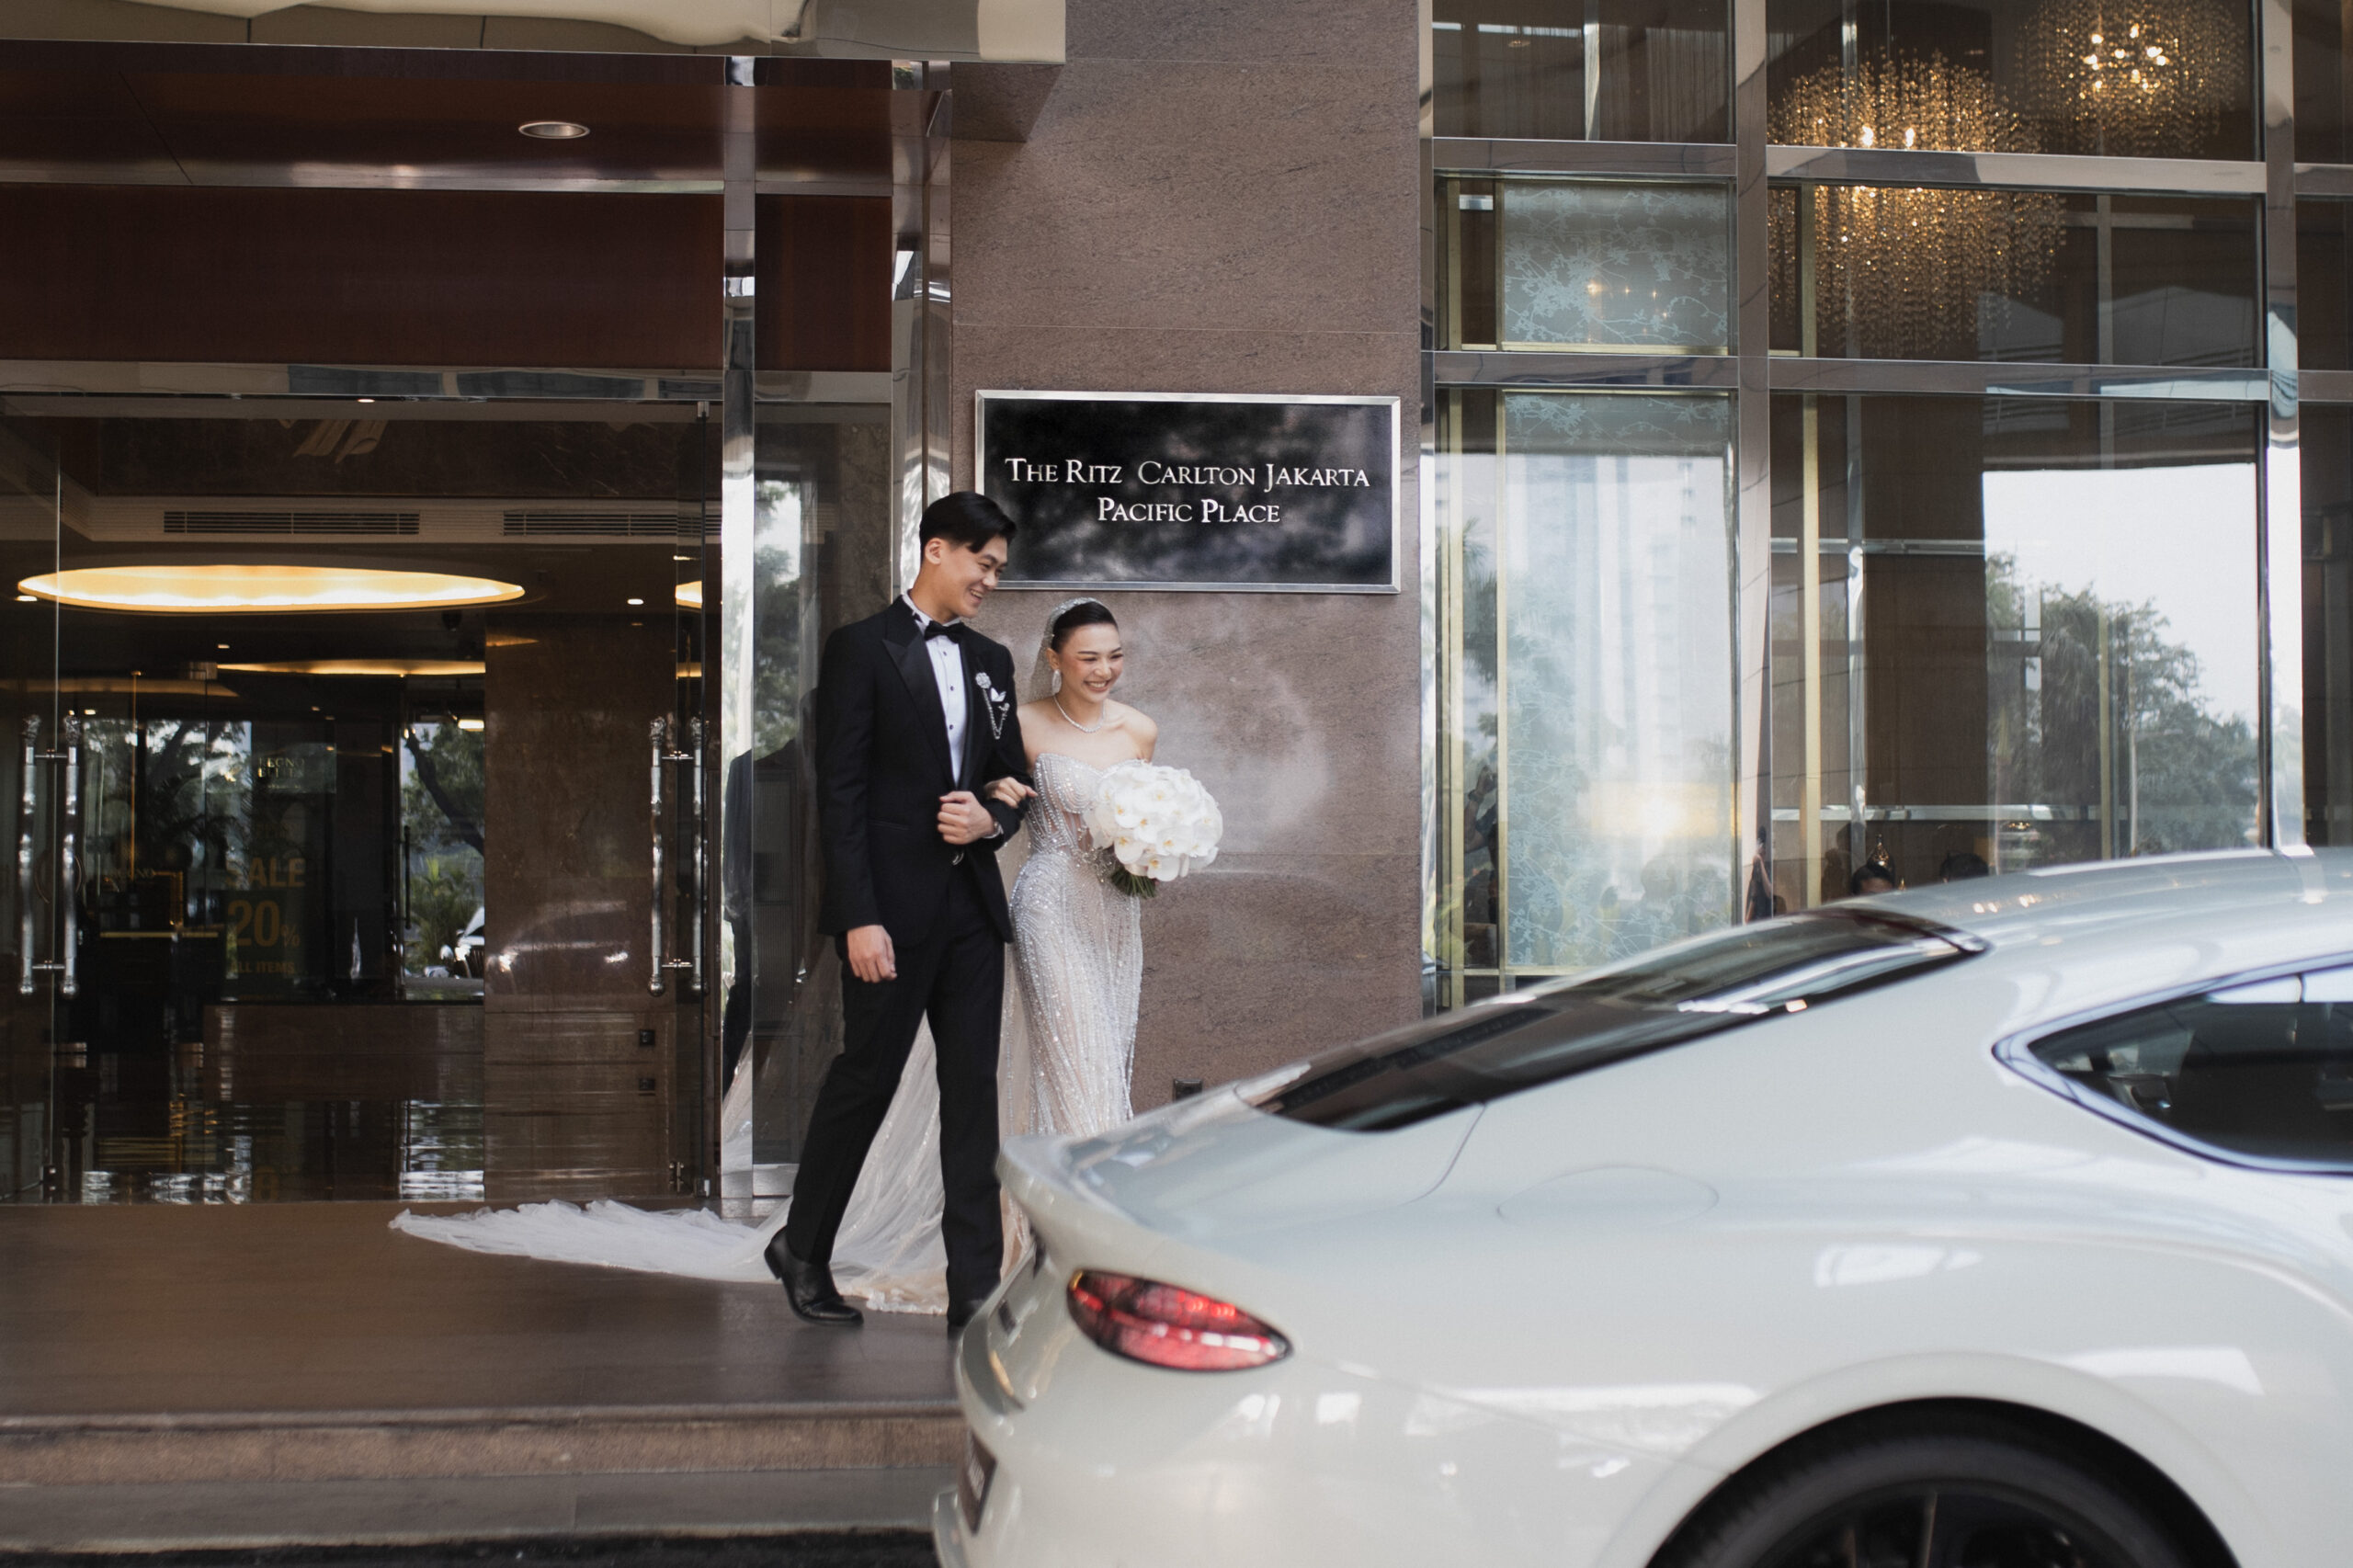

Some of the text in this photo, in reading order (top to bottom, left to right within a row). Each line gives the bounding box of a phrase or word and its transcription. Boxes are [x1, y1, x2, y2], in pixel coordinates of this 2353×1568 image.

[1005, 458, 1370, 493] THE RITZ CARLTON JAKARTA
[1097, 497, 1281, 524] PACIFIC PLACE
[225, 857, 305, 888] SALE
[256, 960, 295, 974] ITEMS
